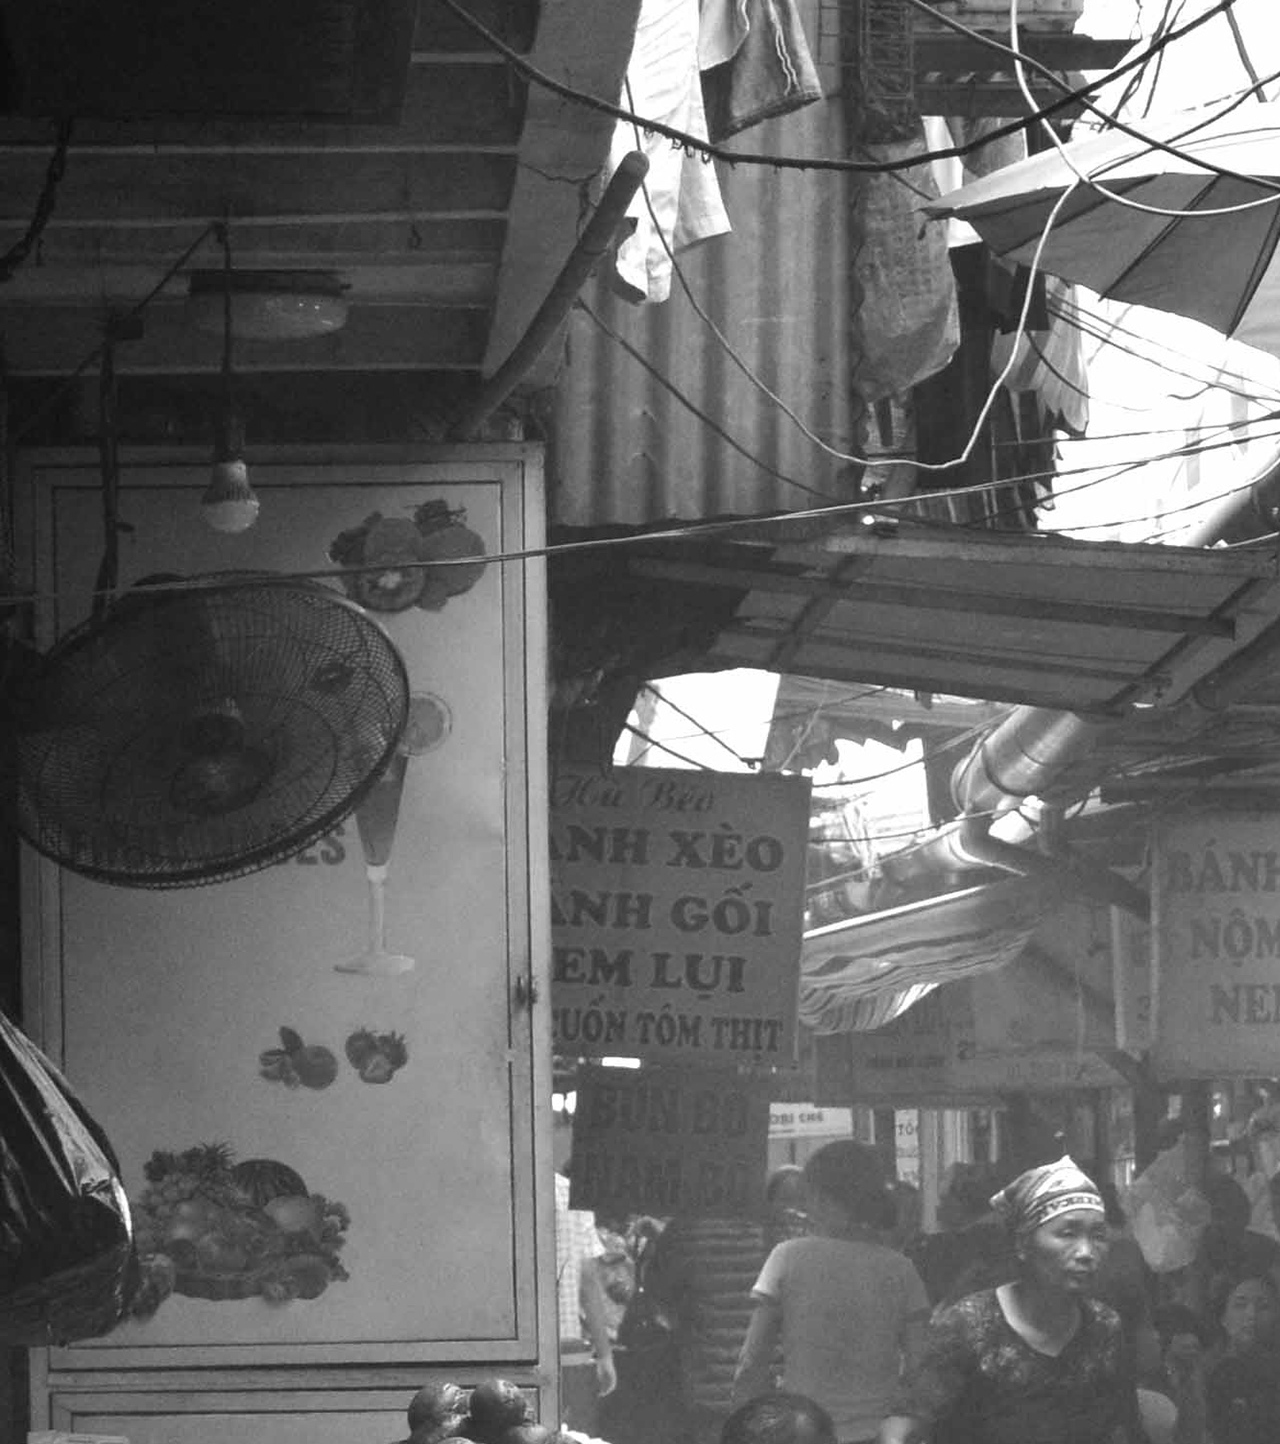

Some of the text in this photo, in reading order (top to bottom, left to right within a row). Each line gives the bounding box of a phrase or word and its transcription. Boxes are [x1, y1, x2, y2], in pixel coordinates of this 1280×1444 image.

[666, 822, 784, 872] XÈO
[671, 881, 774, 937] GỐI
[552, 948, 748, 1000] EM LỤI
[552, 994, 627, 1043] UỐN
